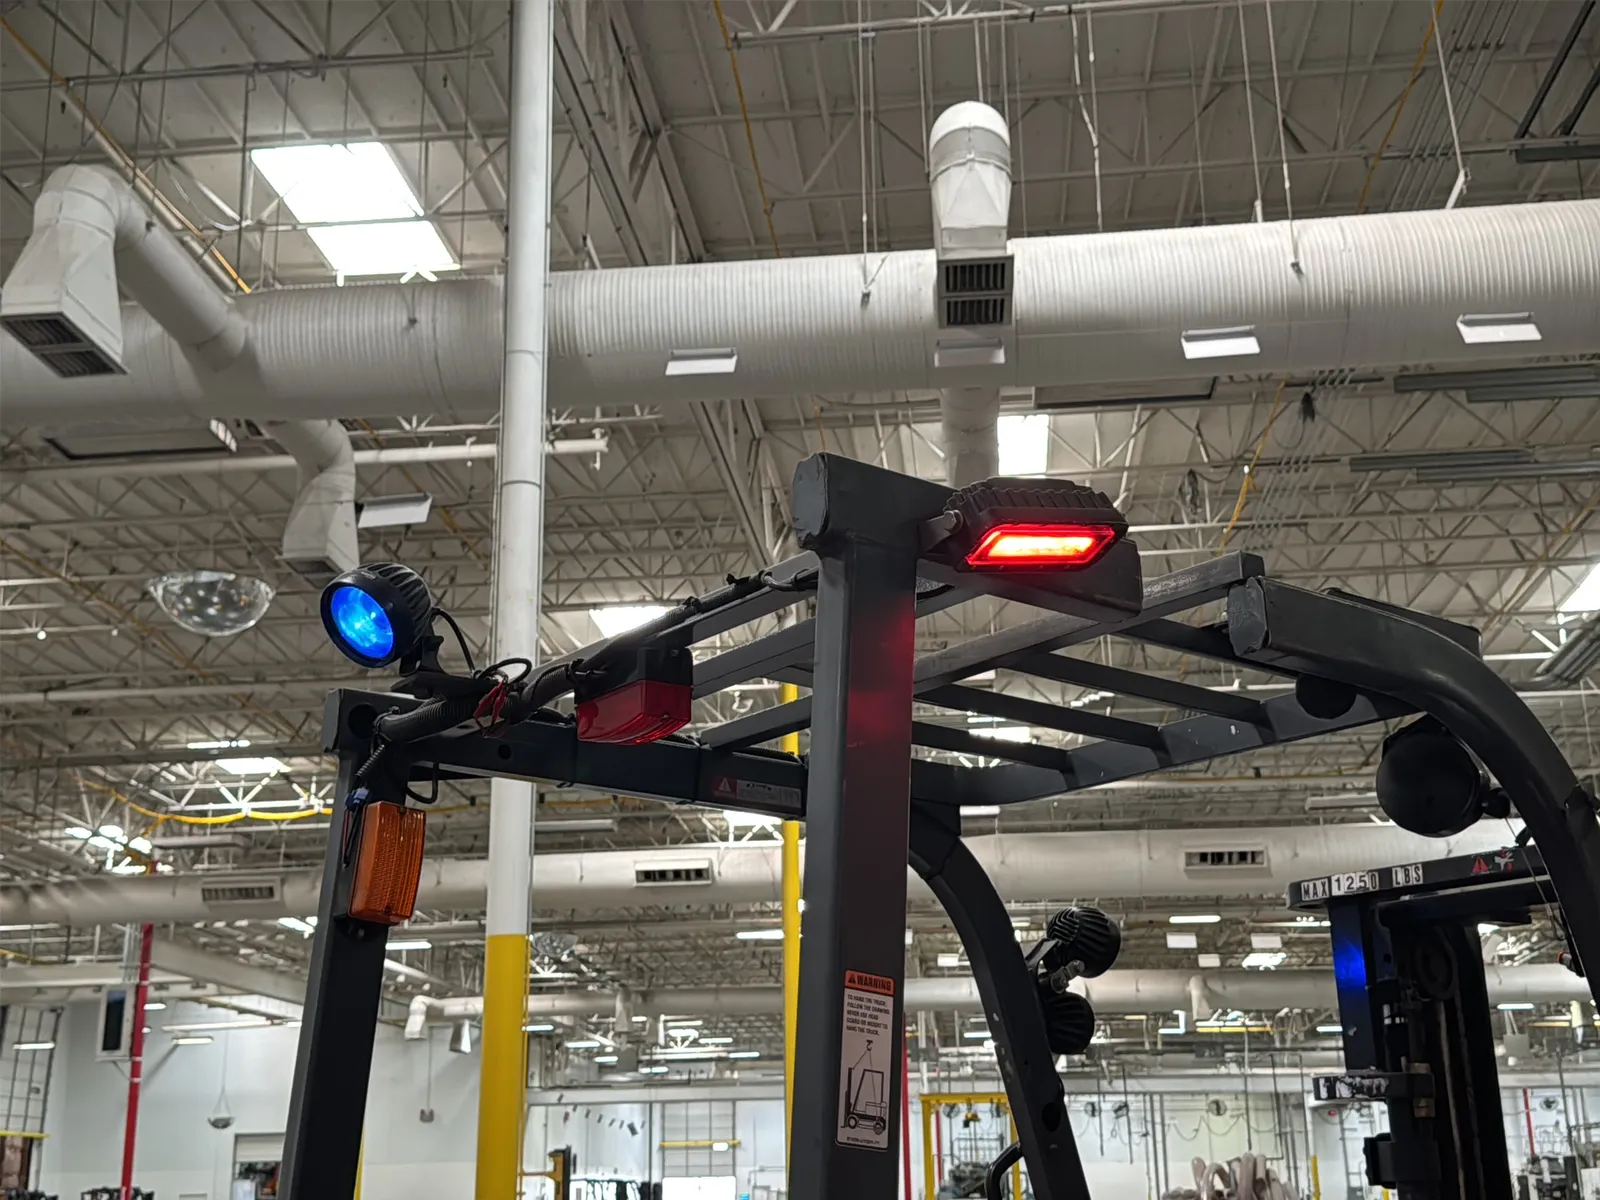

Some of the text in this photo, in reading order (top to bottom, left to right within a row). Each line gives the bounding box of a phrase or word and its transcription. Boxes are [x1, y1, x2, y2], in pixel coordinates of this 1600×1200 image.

[1303, 865, 1421, 899] MAX 1250 LBS
[857, 975, 891, 991] WARNING
[847, 1002, 863, 1010] FOLLOW
[847, 1009, 859, 1017] NEVER
